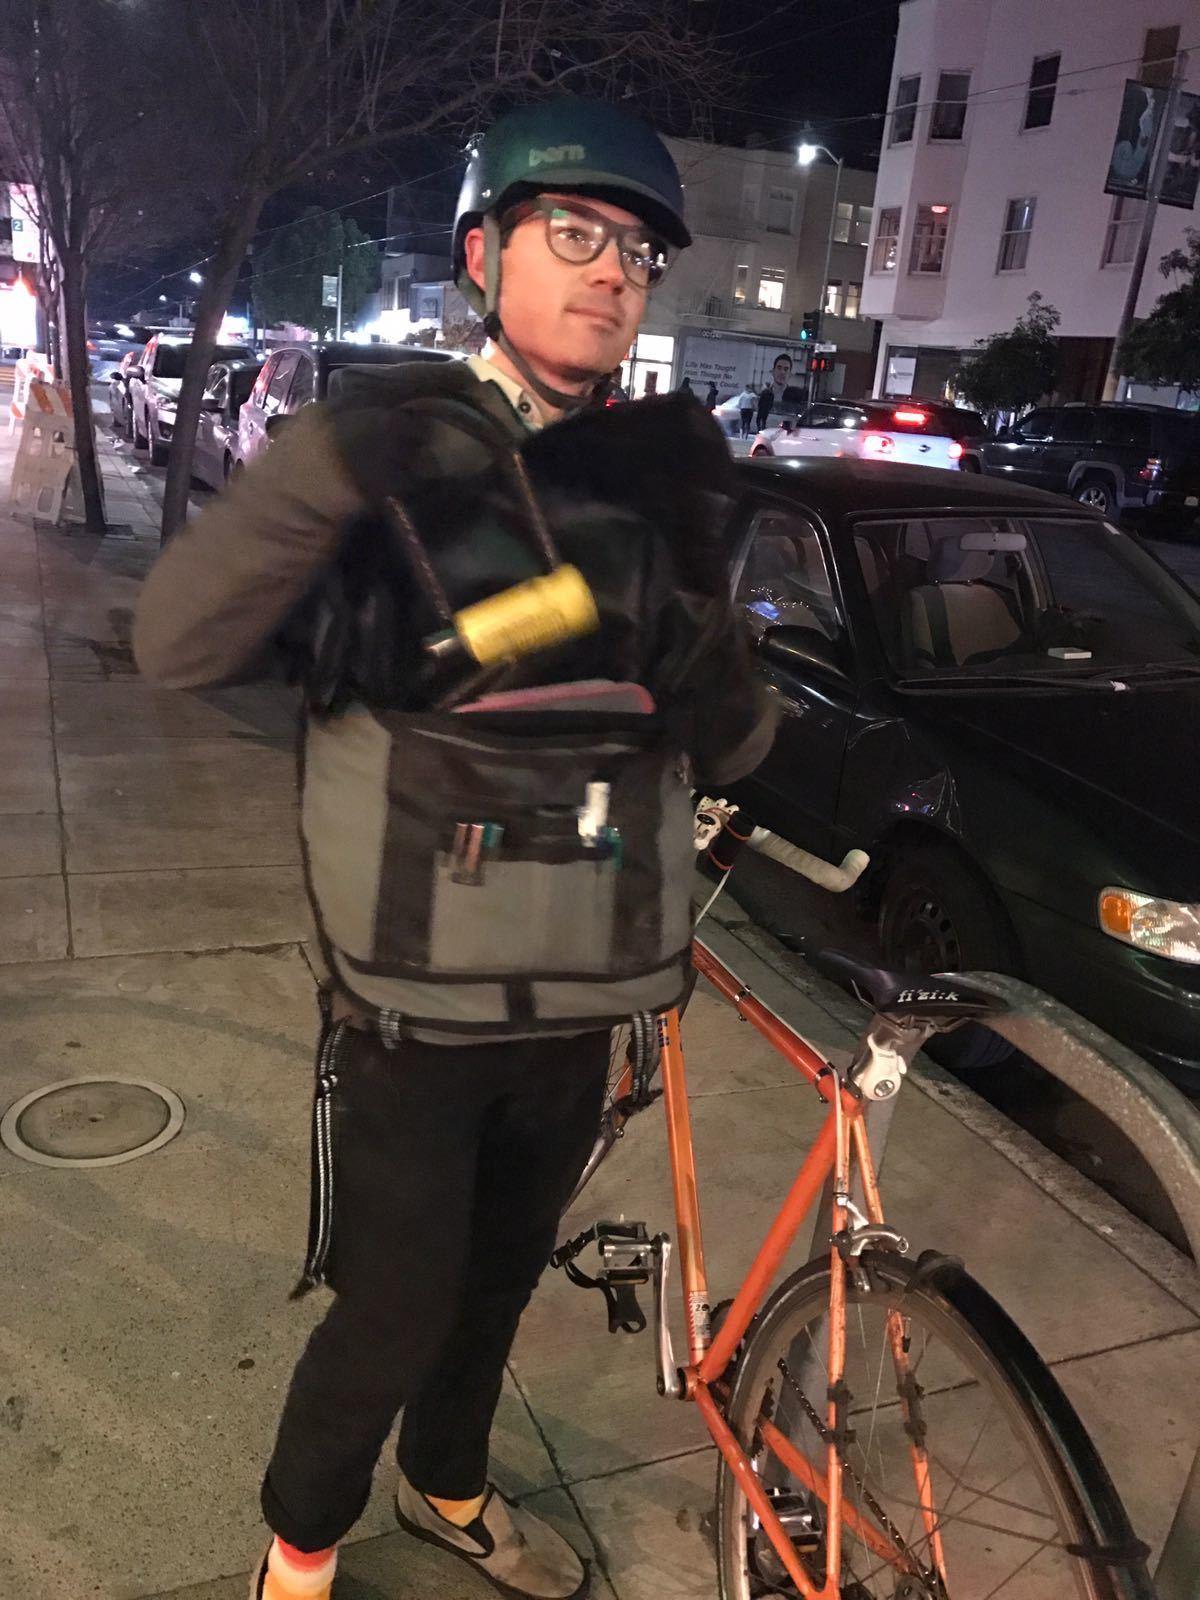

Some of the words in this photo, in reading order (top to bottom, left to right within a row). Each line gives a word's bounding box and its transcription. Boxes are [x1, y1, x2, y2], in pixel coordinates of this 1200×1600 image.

[699, 362, 711, 370] Has
[714, 364, 736, 372] Taught
[699, 371, 721, 379] Things
